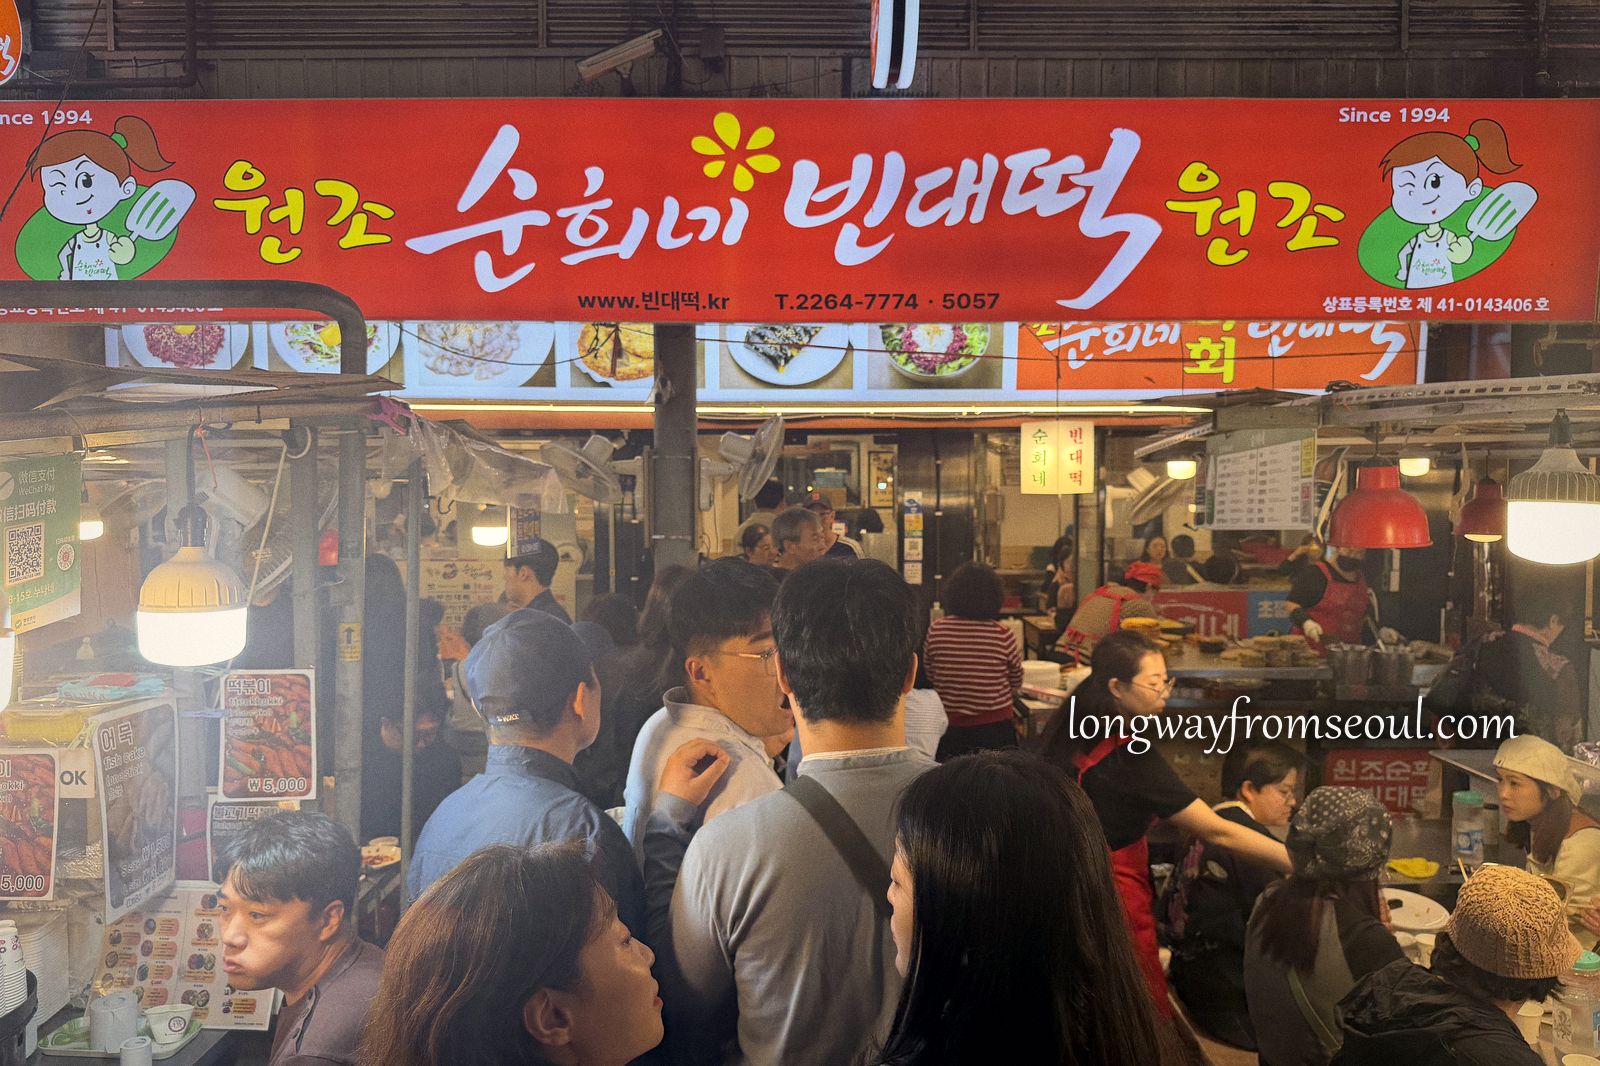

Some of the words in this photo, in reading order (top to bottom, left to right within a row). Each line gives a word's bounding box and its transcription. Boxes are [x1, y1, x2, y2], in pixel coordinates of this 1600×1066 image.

[41, 110, 93, 125] 1994
[1338, 107, 1391, 123] Since
[1399, 107, 1450, 123] 1994
[213, 159, 395, 265] 원조
[405, 123, 749, 293] 순희네
[1165, 161, 1346, 267] 원조
[784, 127, 1162, 309] 빈대떡
[577, 290, 730, 311] www.빈대떡.kr
[775, 292, 919, 310] T.2264-7774
[942, 292, 1000, 310] 5057
[1322, 296, 1413, 314] 상표등록번호
[1416, 296, 1432, 314] 제
[1032, 428, 1047, 488] 순희네
[1069, 427, 1084, 488] 빈대떡
[18, 466, 55, 485] 微信支付
[0, 498, 57, 523] 信扫码付款
[227, 678, 272, 696] 떡볶이
[59, 770, 88, 786] OK
[263, 776, 307, 795] 5,000
[0, 874, 45, 893] 5,000
